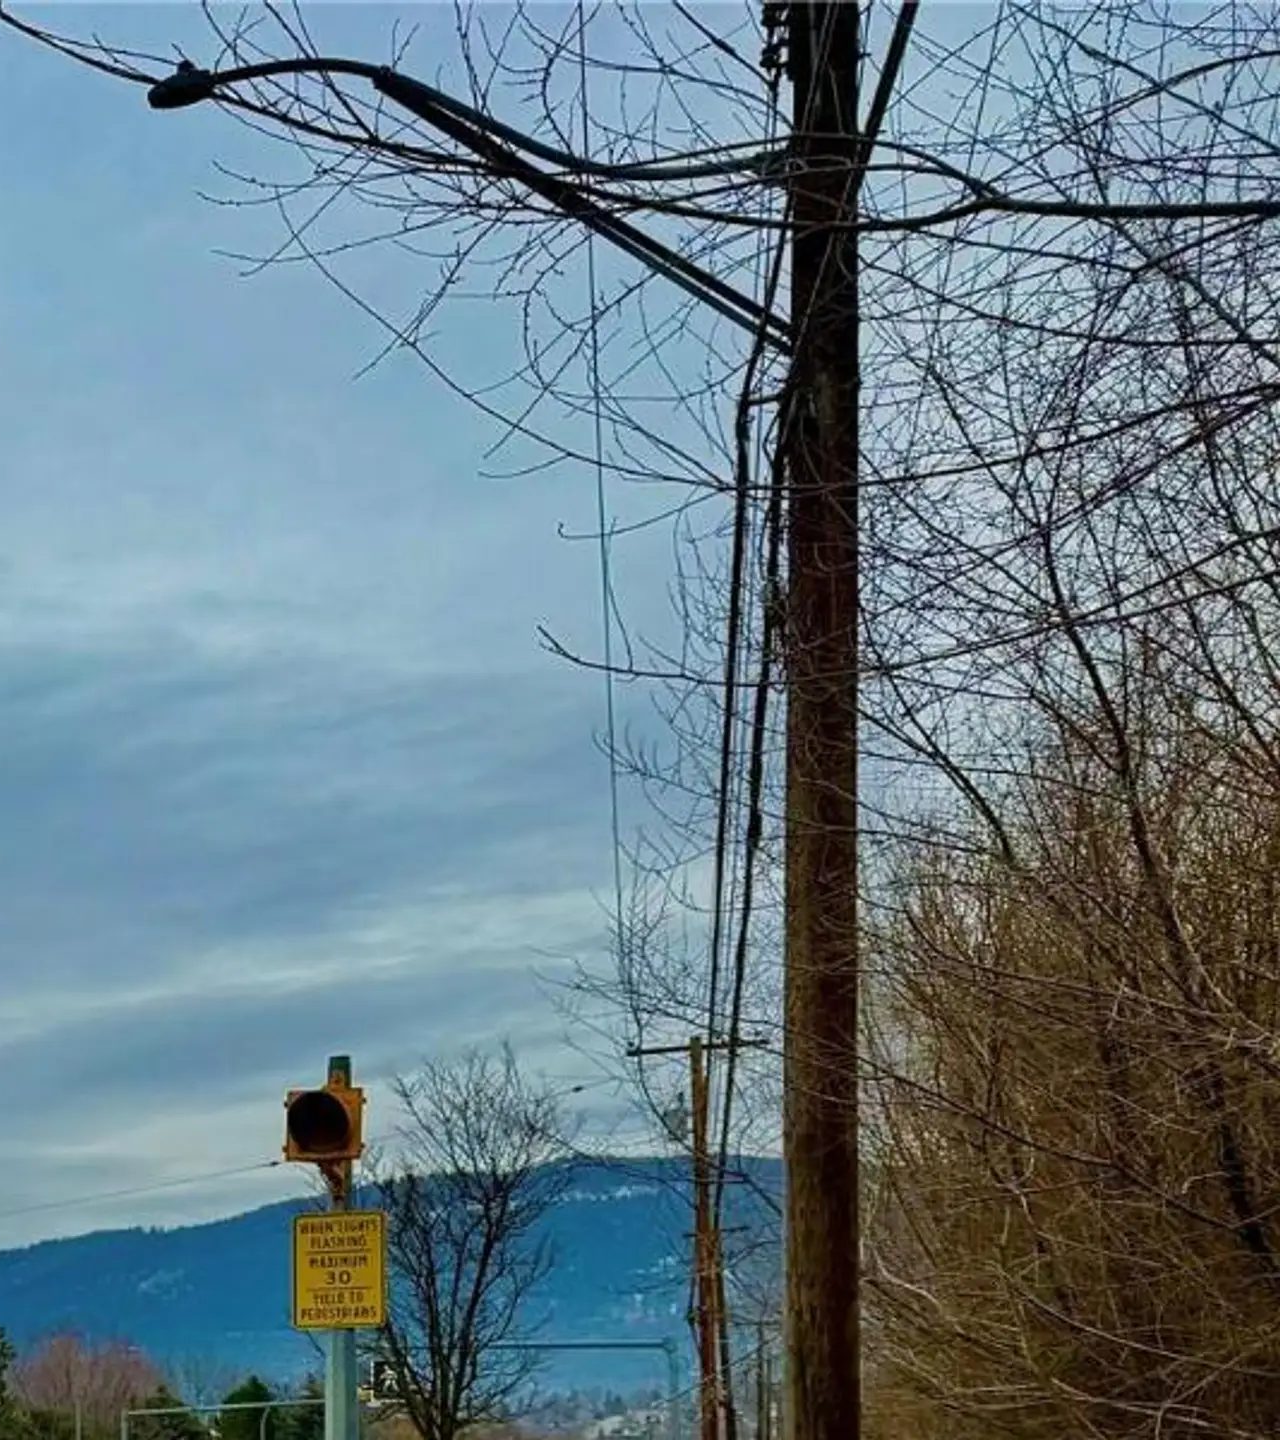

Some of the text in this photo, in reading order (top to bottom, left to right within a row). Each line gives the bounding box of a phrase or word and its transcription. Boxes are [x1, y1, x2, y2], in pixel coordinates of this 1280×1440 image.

[310, 1235, 367, 1248] FLASHING
[325, 1270, 351, 1285] 30
[349, 1291, 364, 1302] TO
[301, 1306, 377, 1320] PEDESTRIANS
